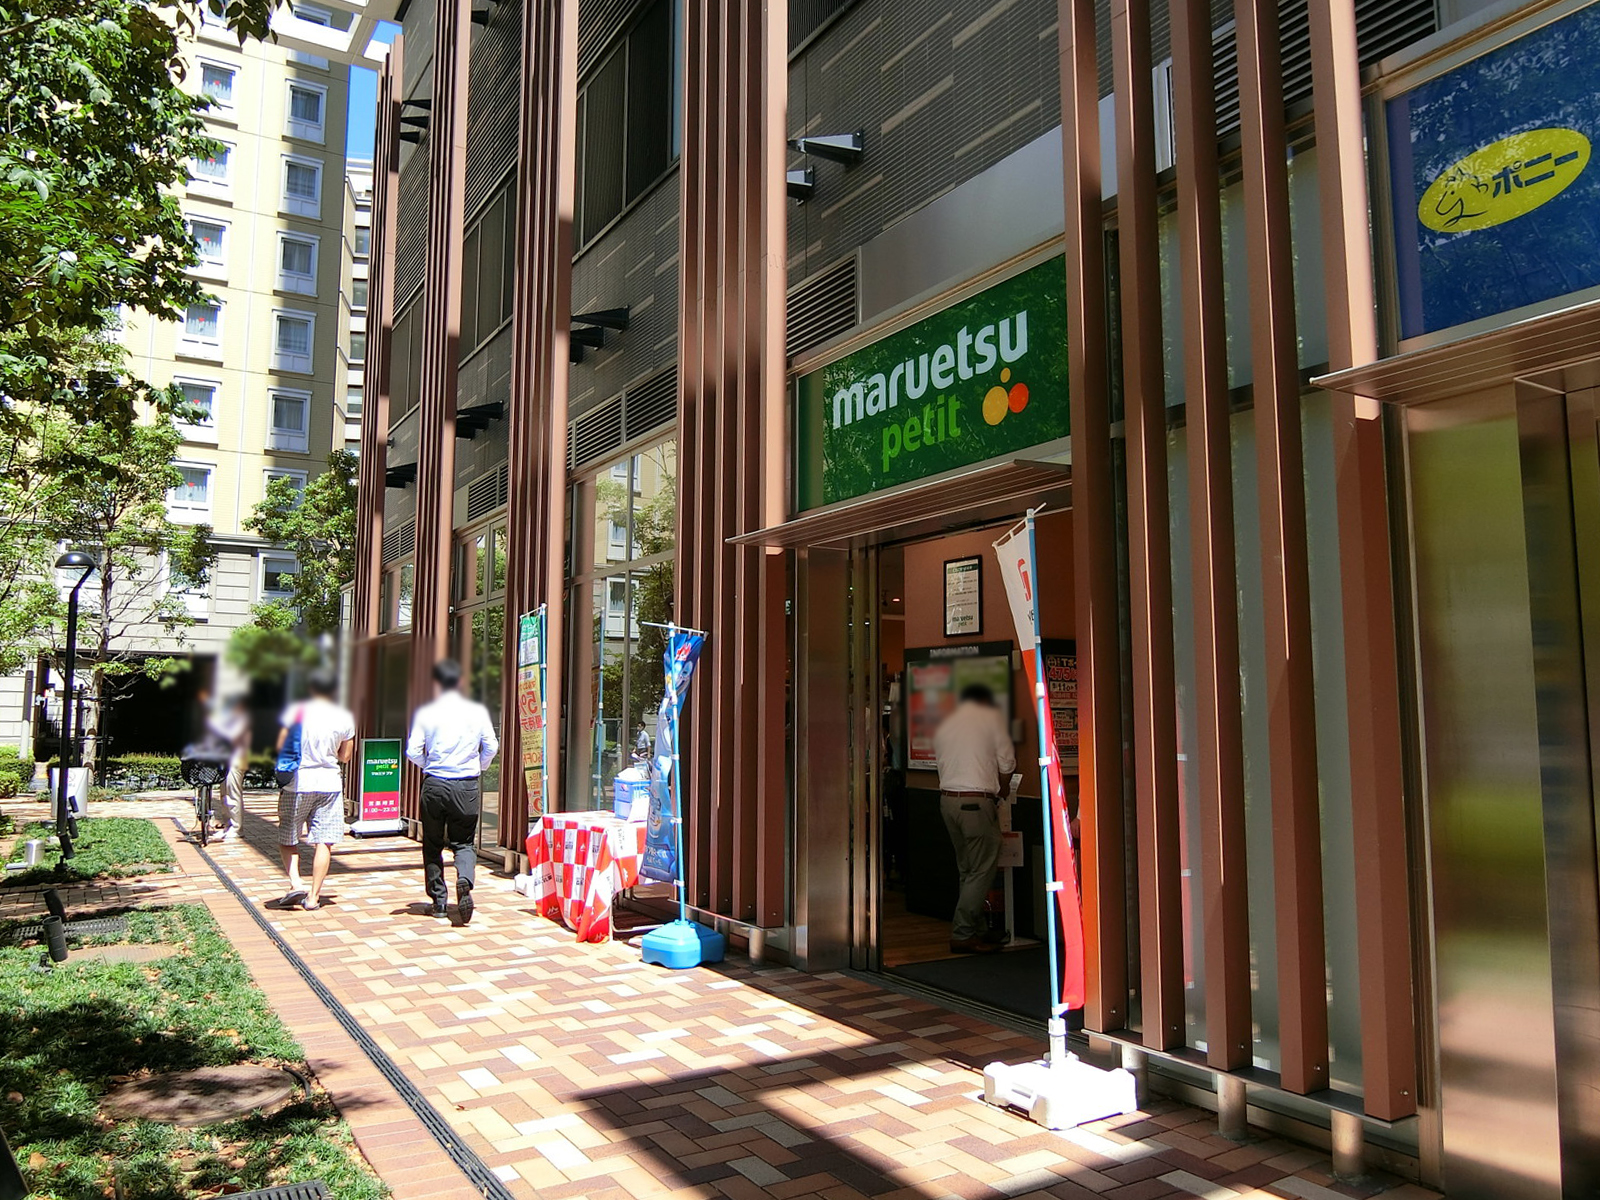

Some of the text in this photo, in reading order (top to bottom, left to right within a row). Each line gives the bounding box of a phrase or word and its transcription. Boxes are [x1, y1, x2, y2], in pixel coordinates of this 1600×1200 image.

[1492, 150, 1579, 198] ポニー
[832, 310, 1028, 430] maruetsu
[882, 394, 962, 473] petit
[929, 645, 980, 658] INFORMATION
